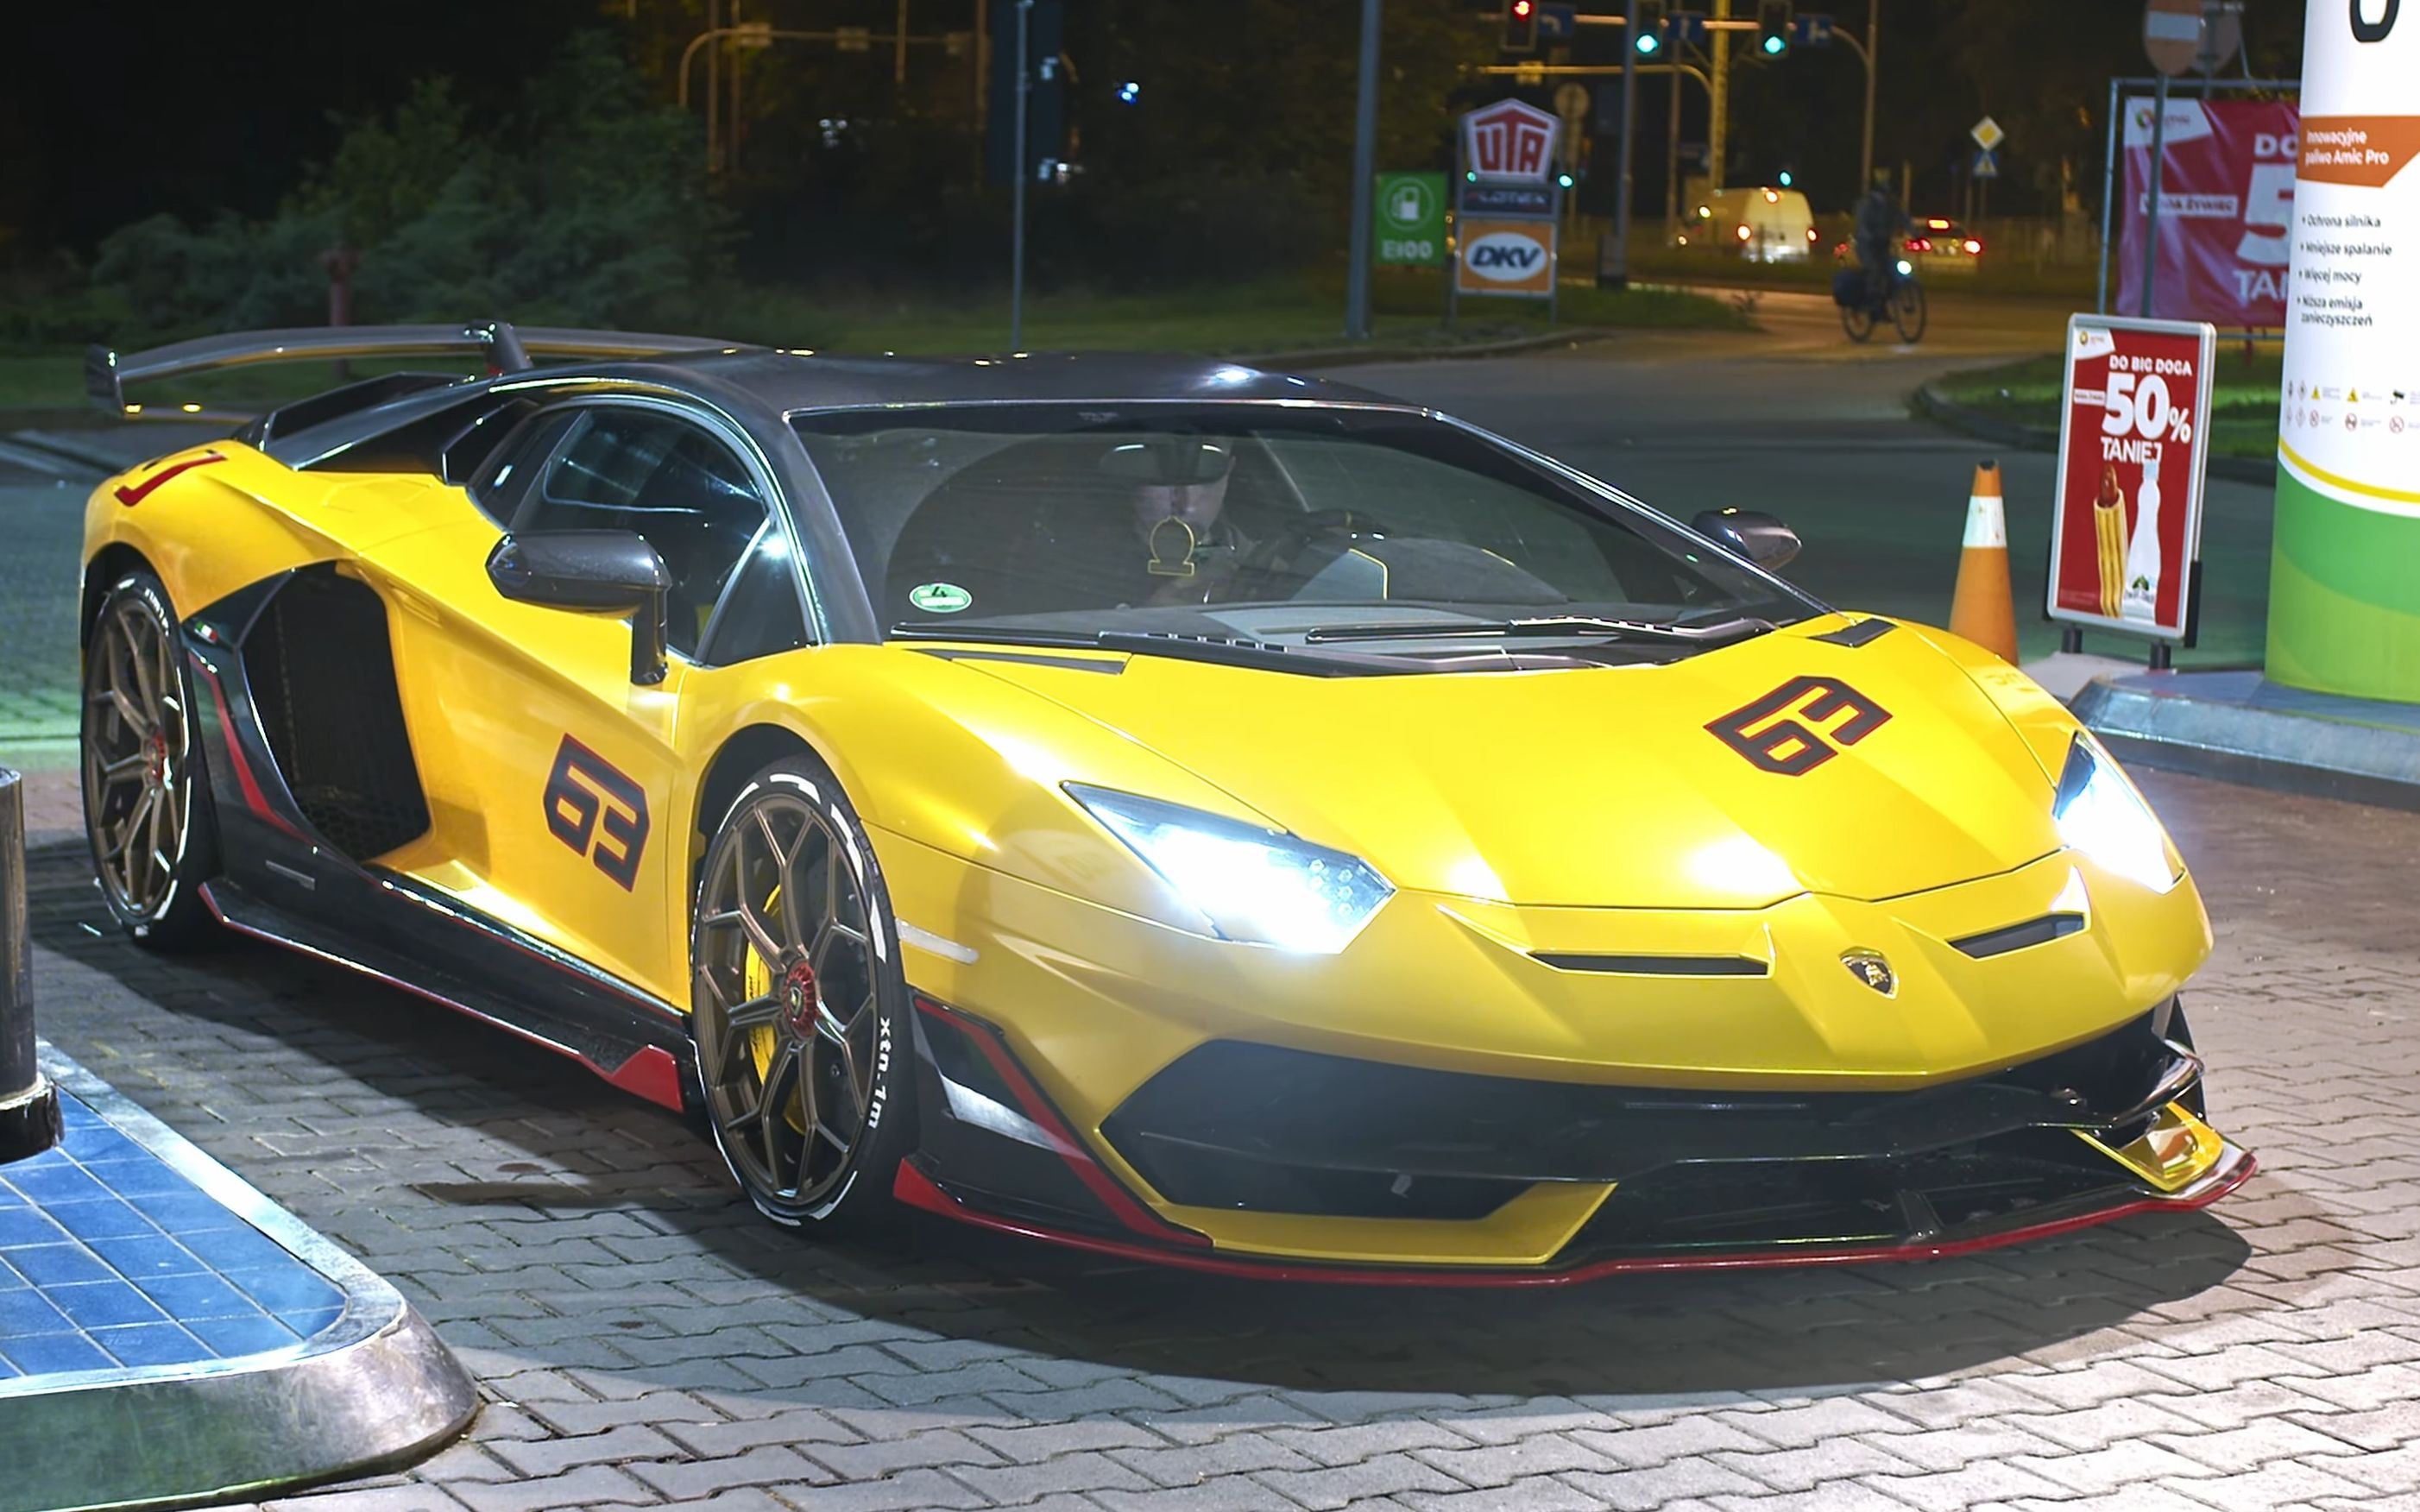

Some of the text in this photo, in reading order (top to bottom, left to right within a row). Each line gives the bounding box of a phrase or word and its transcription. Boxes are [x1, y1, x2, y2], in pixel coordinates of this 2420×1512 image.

[1474, 109, 1550, 172] UTA
[2334, 148, 2363, 166] Amic
[2366, 148, 2389, 166] Pro
[2308, 214, 2381, 227] Ochrona silnika
[1472, 246, 1541, 268] DKV
[2344, 243, 2392, 258] spalanie
[2333, 272, 2361, 286] mocy
[2329, 297, 2363, 312] emisja
[2109, 354, 2193, 377] DO BIG DOGA
[2102, 370, 2192, 444] 50%
[2101, 436, 2163, 464] TANIEJ
[1703, 675, 1894, 777] 63
[543, 732, 651, 893] 63
